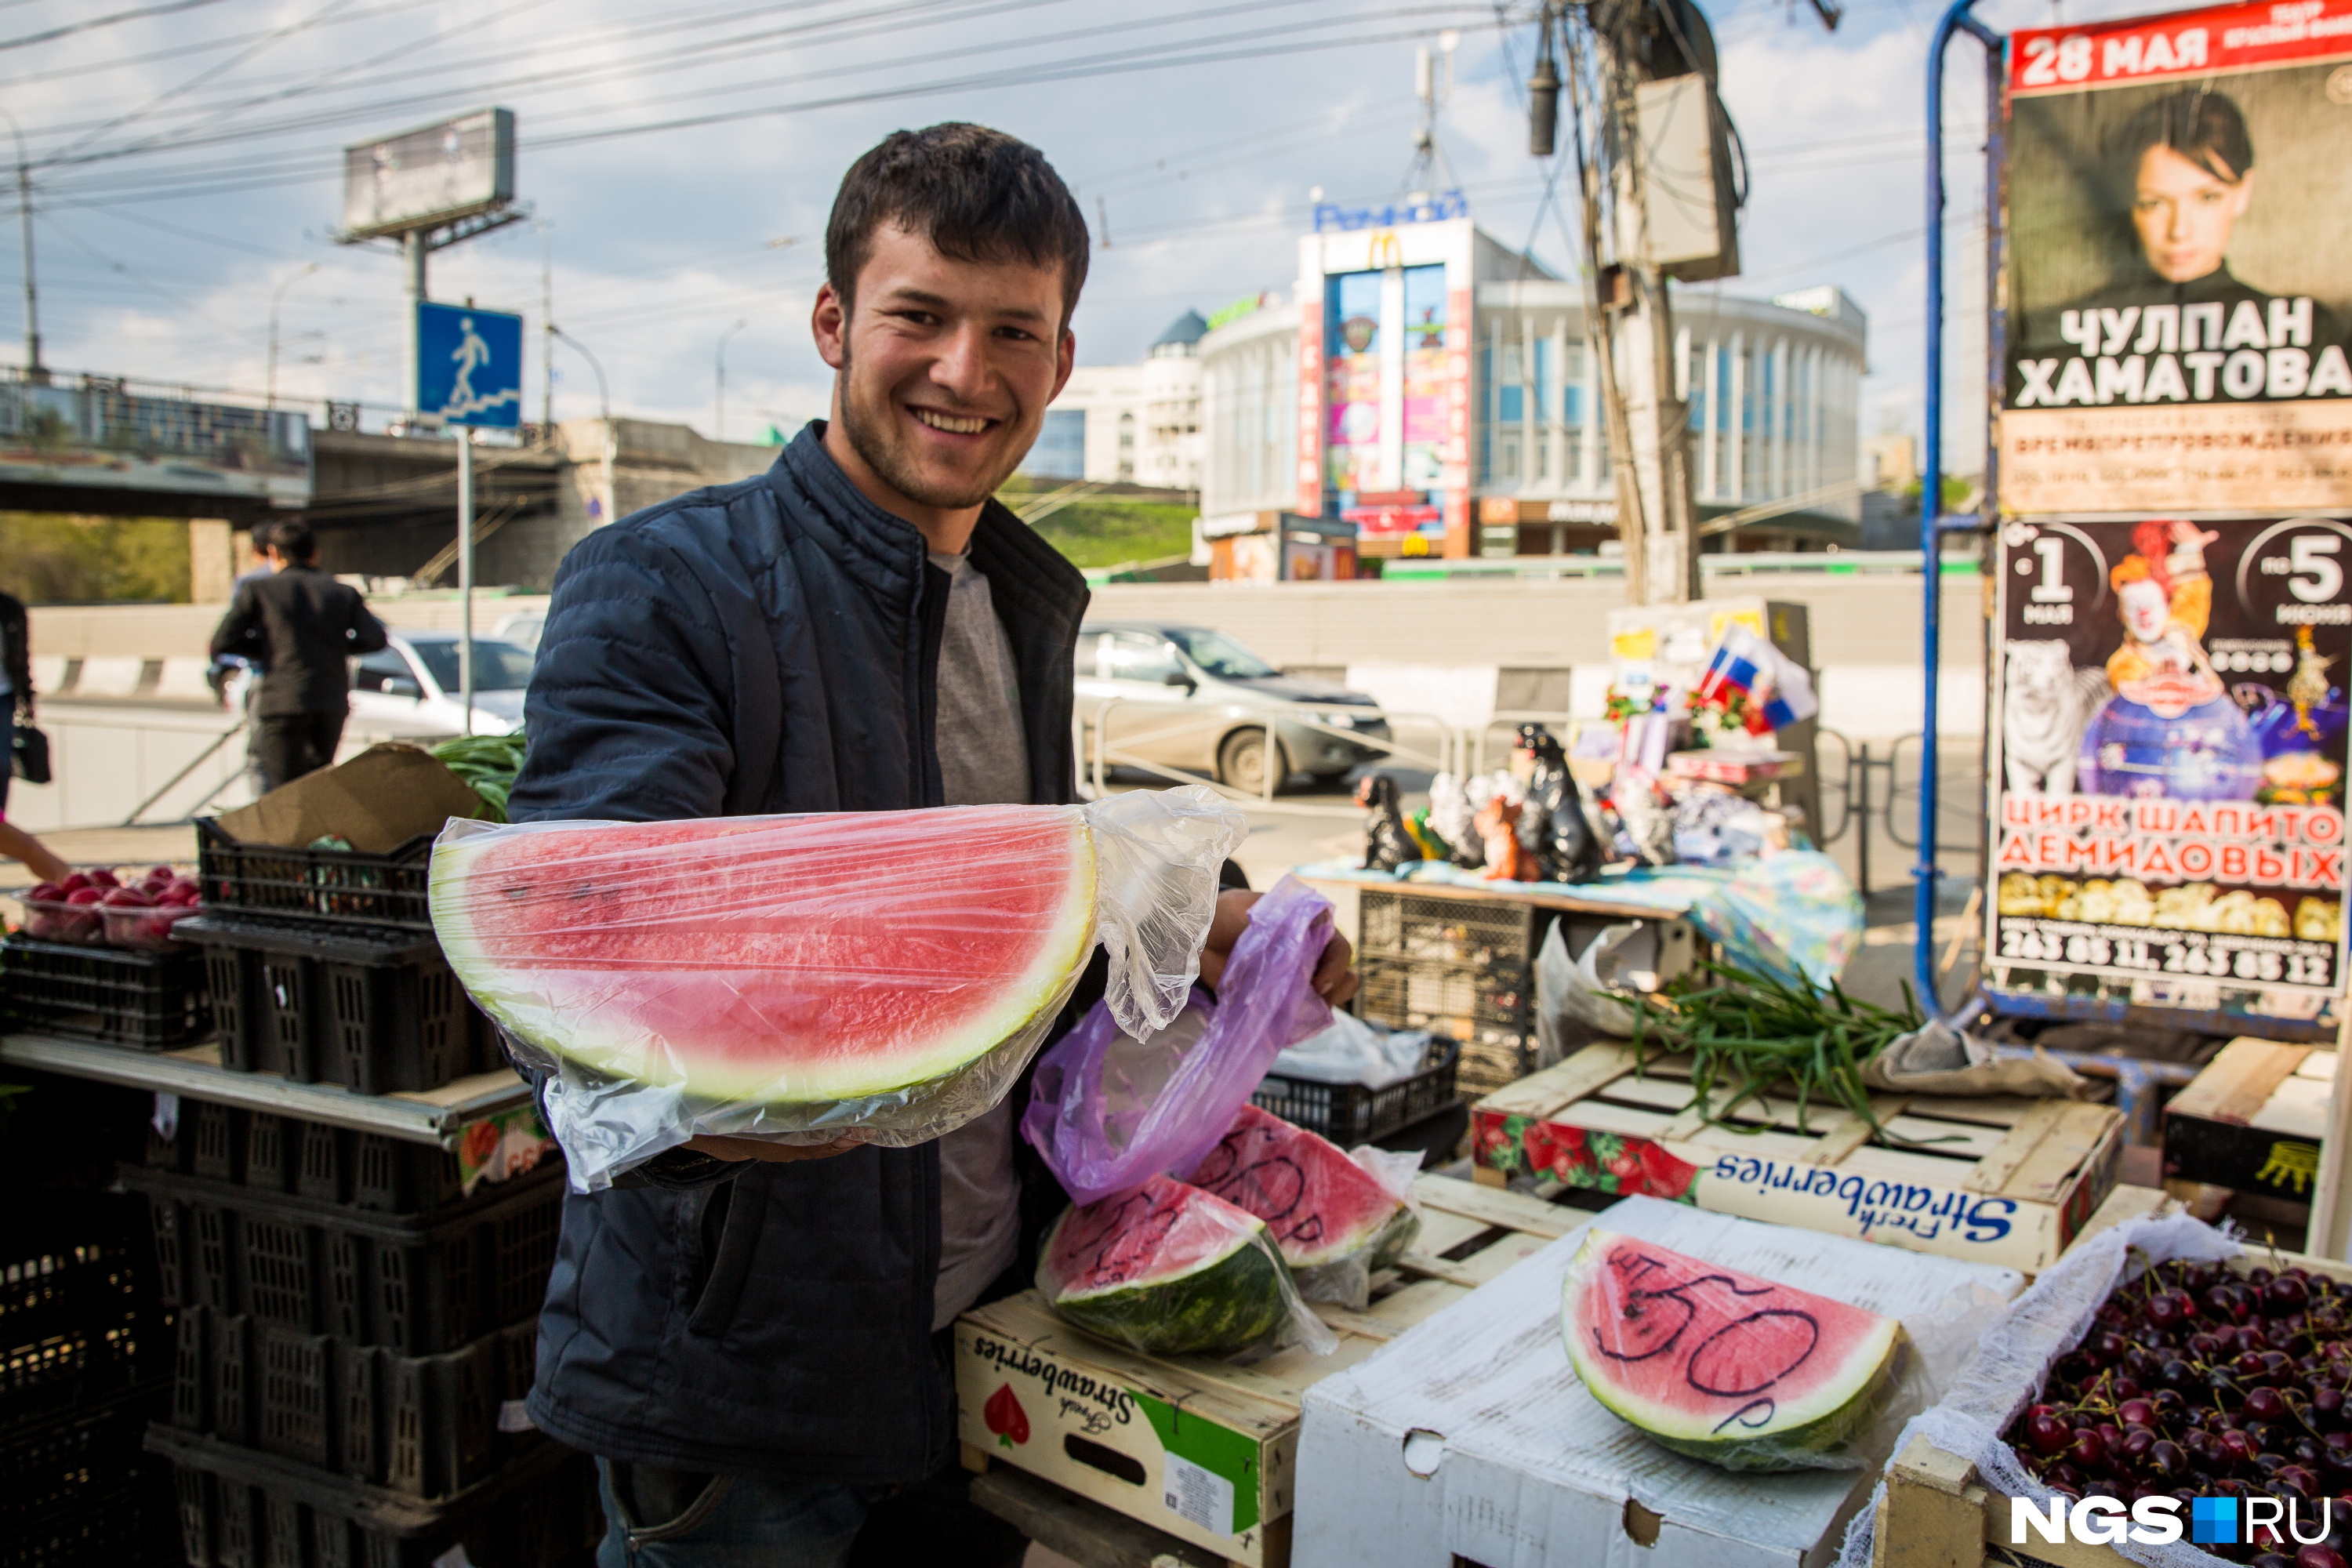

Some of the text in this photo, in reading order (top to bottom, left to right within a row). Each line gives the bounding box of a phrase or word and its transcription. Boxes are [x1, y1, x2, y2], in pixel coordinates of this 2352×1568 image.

[2023, 28, 2209, 85] 28 МАЯ
[2060, 297, 2313, 357] ЧУЛПАН
[2015, 346, 2352, 406] ХАМАТОВА
[2031, 537, 2073, 602] 1
[2288, 535, 2343, 603] 5
[2024, 604, 2073, 625] МАЯ
[2276, 604, 2352, 626] ИЮНЯ
[2004, 795, 2343, 845] ЦИРК ШАПИТО
[2000, 831, 2341, 888] ДЕМИДОВЫХ
[1715, 1154, 2017, 1243] Strawberries
[1860, 1209, 1941, 1240] Fresh
[973, 1335, 1136, 1425] Strawberries
[1059, 1399, 1112, 1435] Fresh
